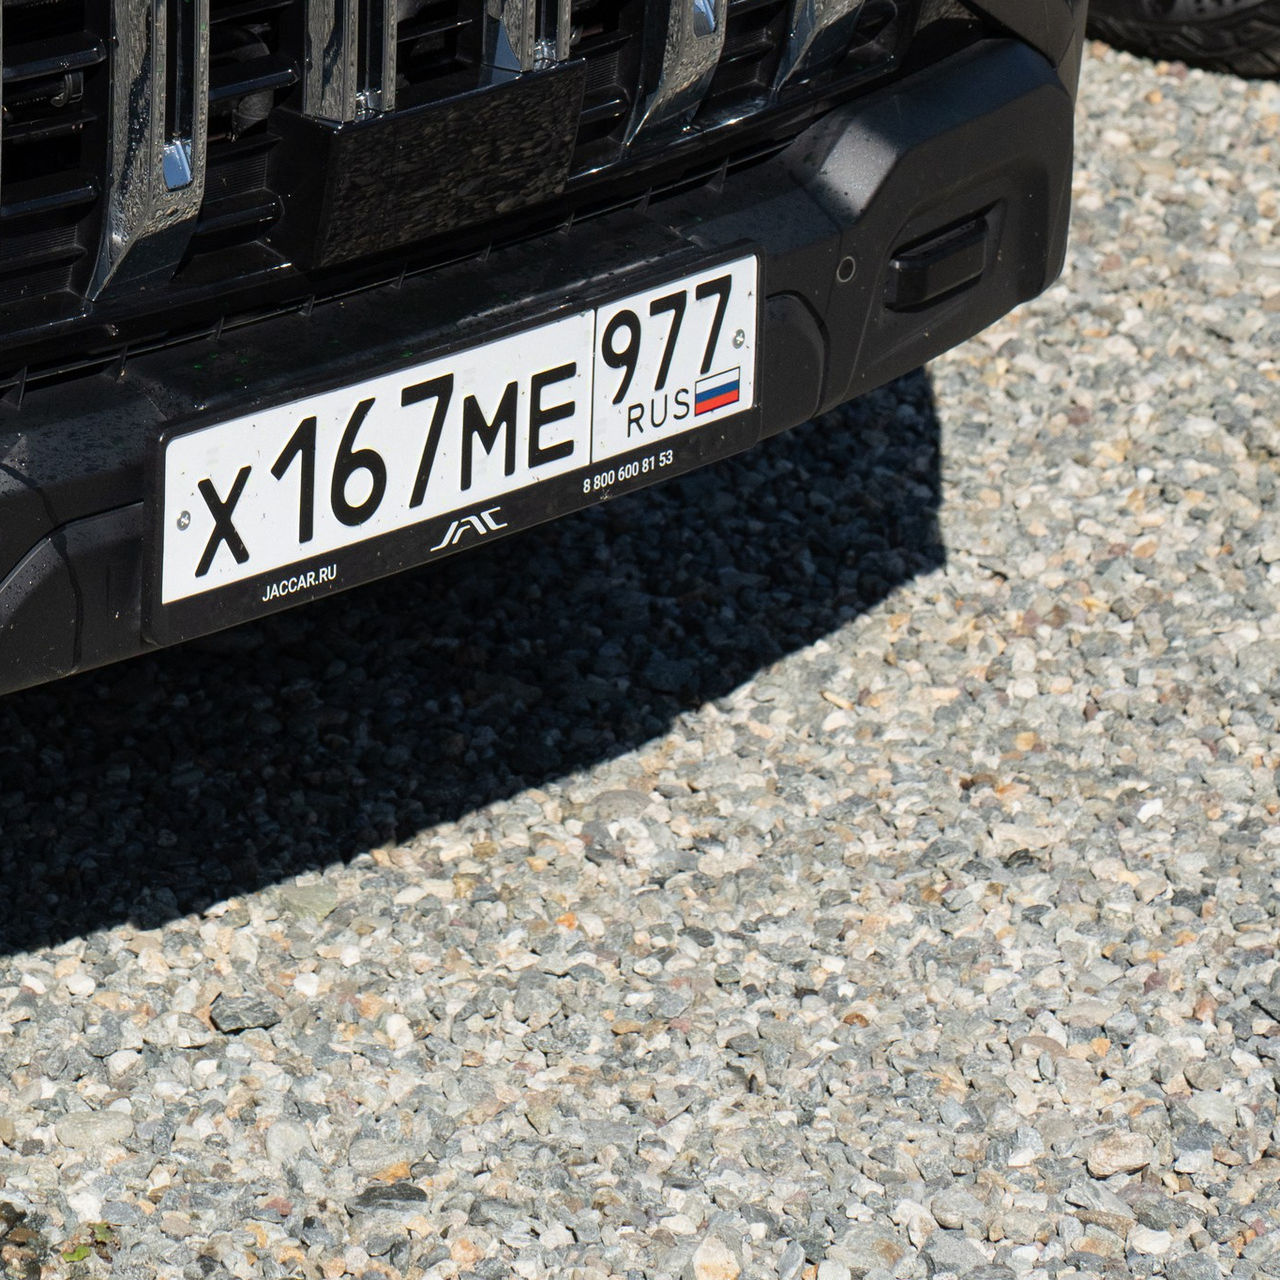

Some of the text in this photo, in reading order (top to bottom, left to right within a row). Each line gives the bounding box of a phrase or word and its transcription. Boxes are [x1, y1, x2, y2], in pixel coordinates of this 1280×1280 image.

[195, 274, 732, 578] X167ME 977
[627, 388, 690, 438] RUS
[593, 470, 615, 490] 800
[618, 461, 639, 481] 600
[642, 455, 655, 473] 81
[659, 449, 673, 467] 53
[430, 506, 508, 552] JAC
[262, 564, 337, 602] JACCAR.RU
